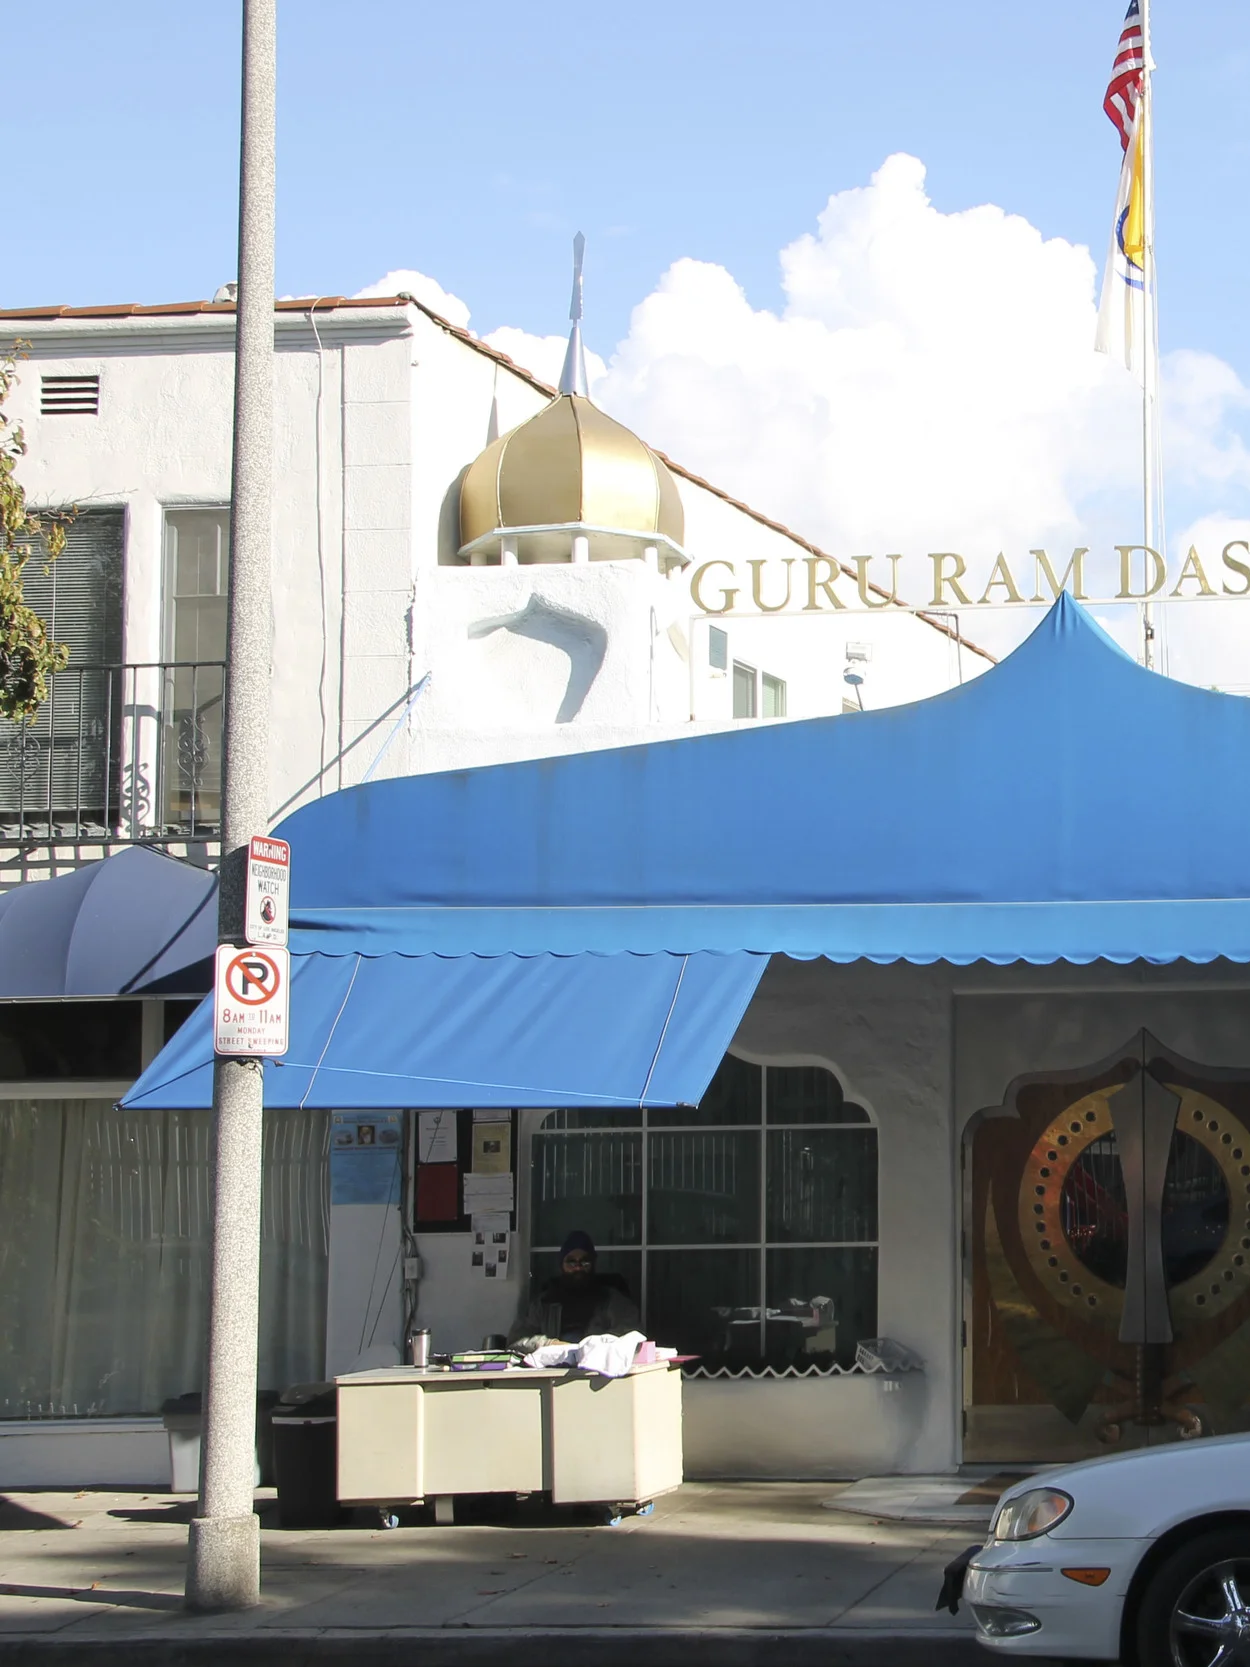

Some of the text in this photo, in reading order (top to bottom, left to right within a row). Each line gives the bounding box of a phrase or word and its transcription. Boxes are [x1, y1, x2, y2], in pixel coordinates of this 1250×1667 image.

[690, 554, 902, 614] GURU
[928, 547, 1090, 606] RAM
[253, 840, 287, 861] WARNING
[252, 863, 287, 881] NEIGHBORHOOD
[257, 880, 280, 895] WATCH
[242, 962, 269, 995] P
[218, 1037, 284, 1046] STREET SWEEPING
